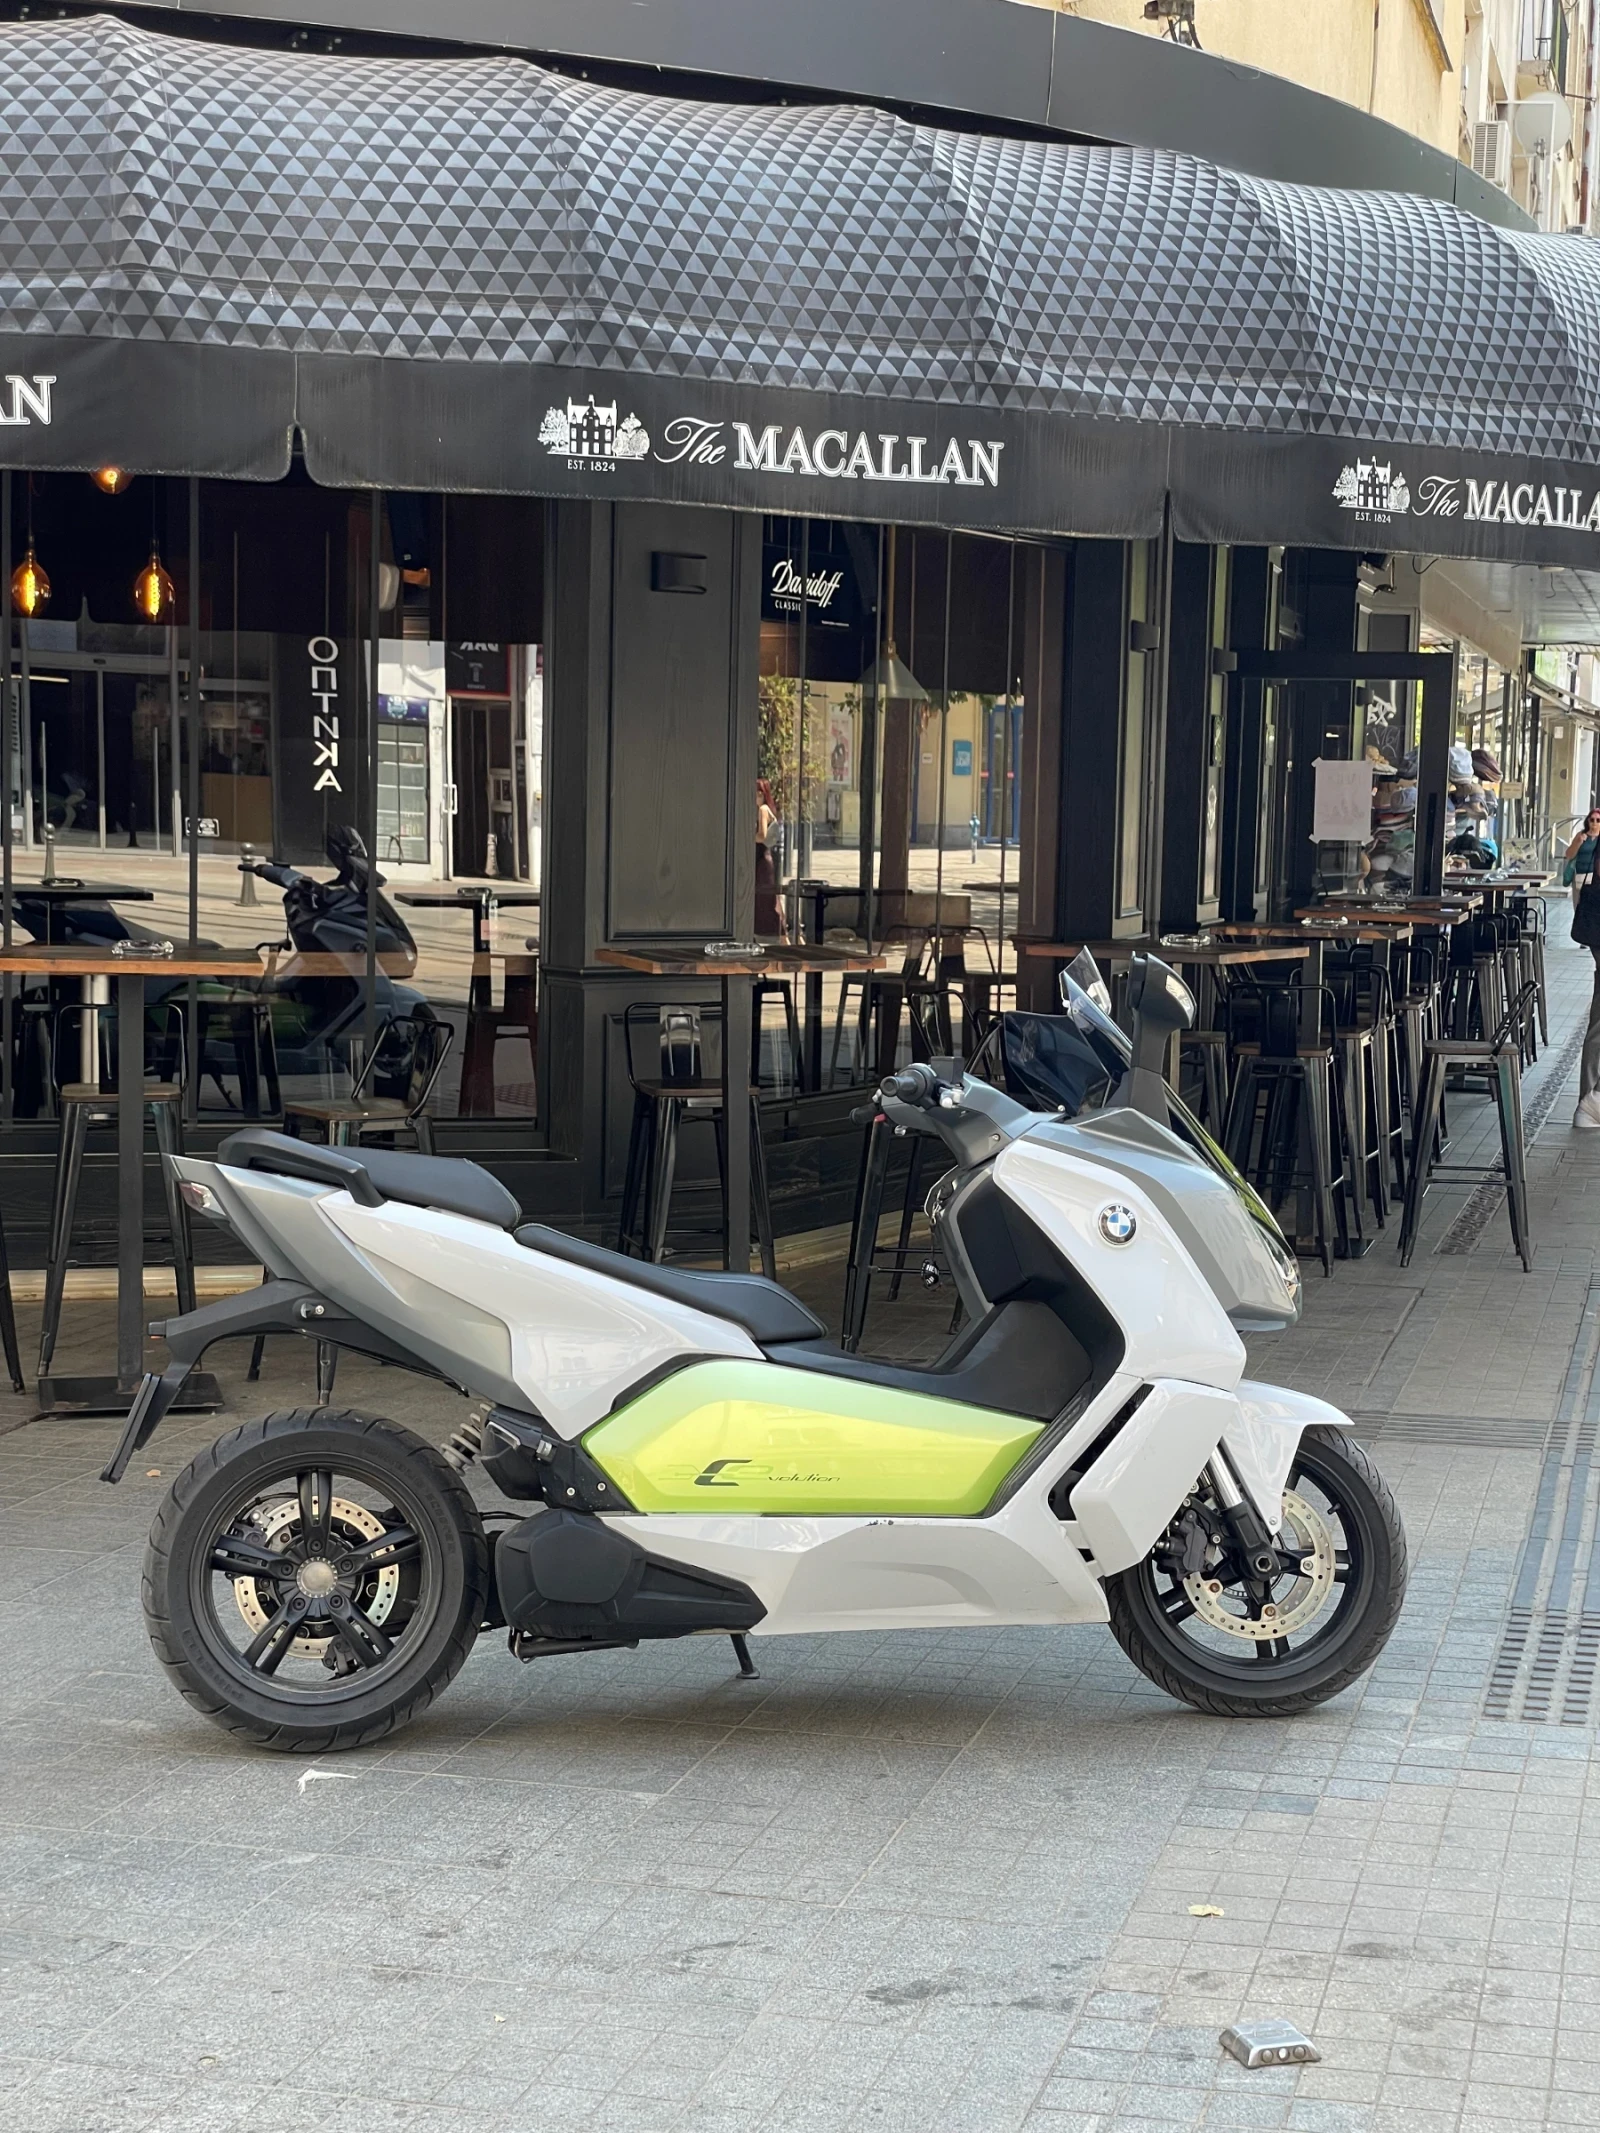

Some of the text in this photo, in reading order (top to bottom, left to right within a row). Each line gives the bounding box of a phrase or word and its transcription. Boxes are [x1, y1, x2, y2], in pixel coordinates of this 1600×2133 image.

[653, 416, 1005, 487] The MACALLAN
[567, 459, 617, 472] EST. 1824
[1411, 475, 1461, 517] The
[1355, 511, 1392, 524] EST. 1824
